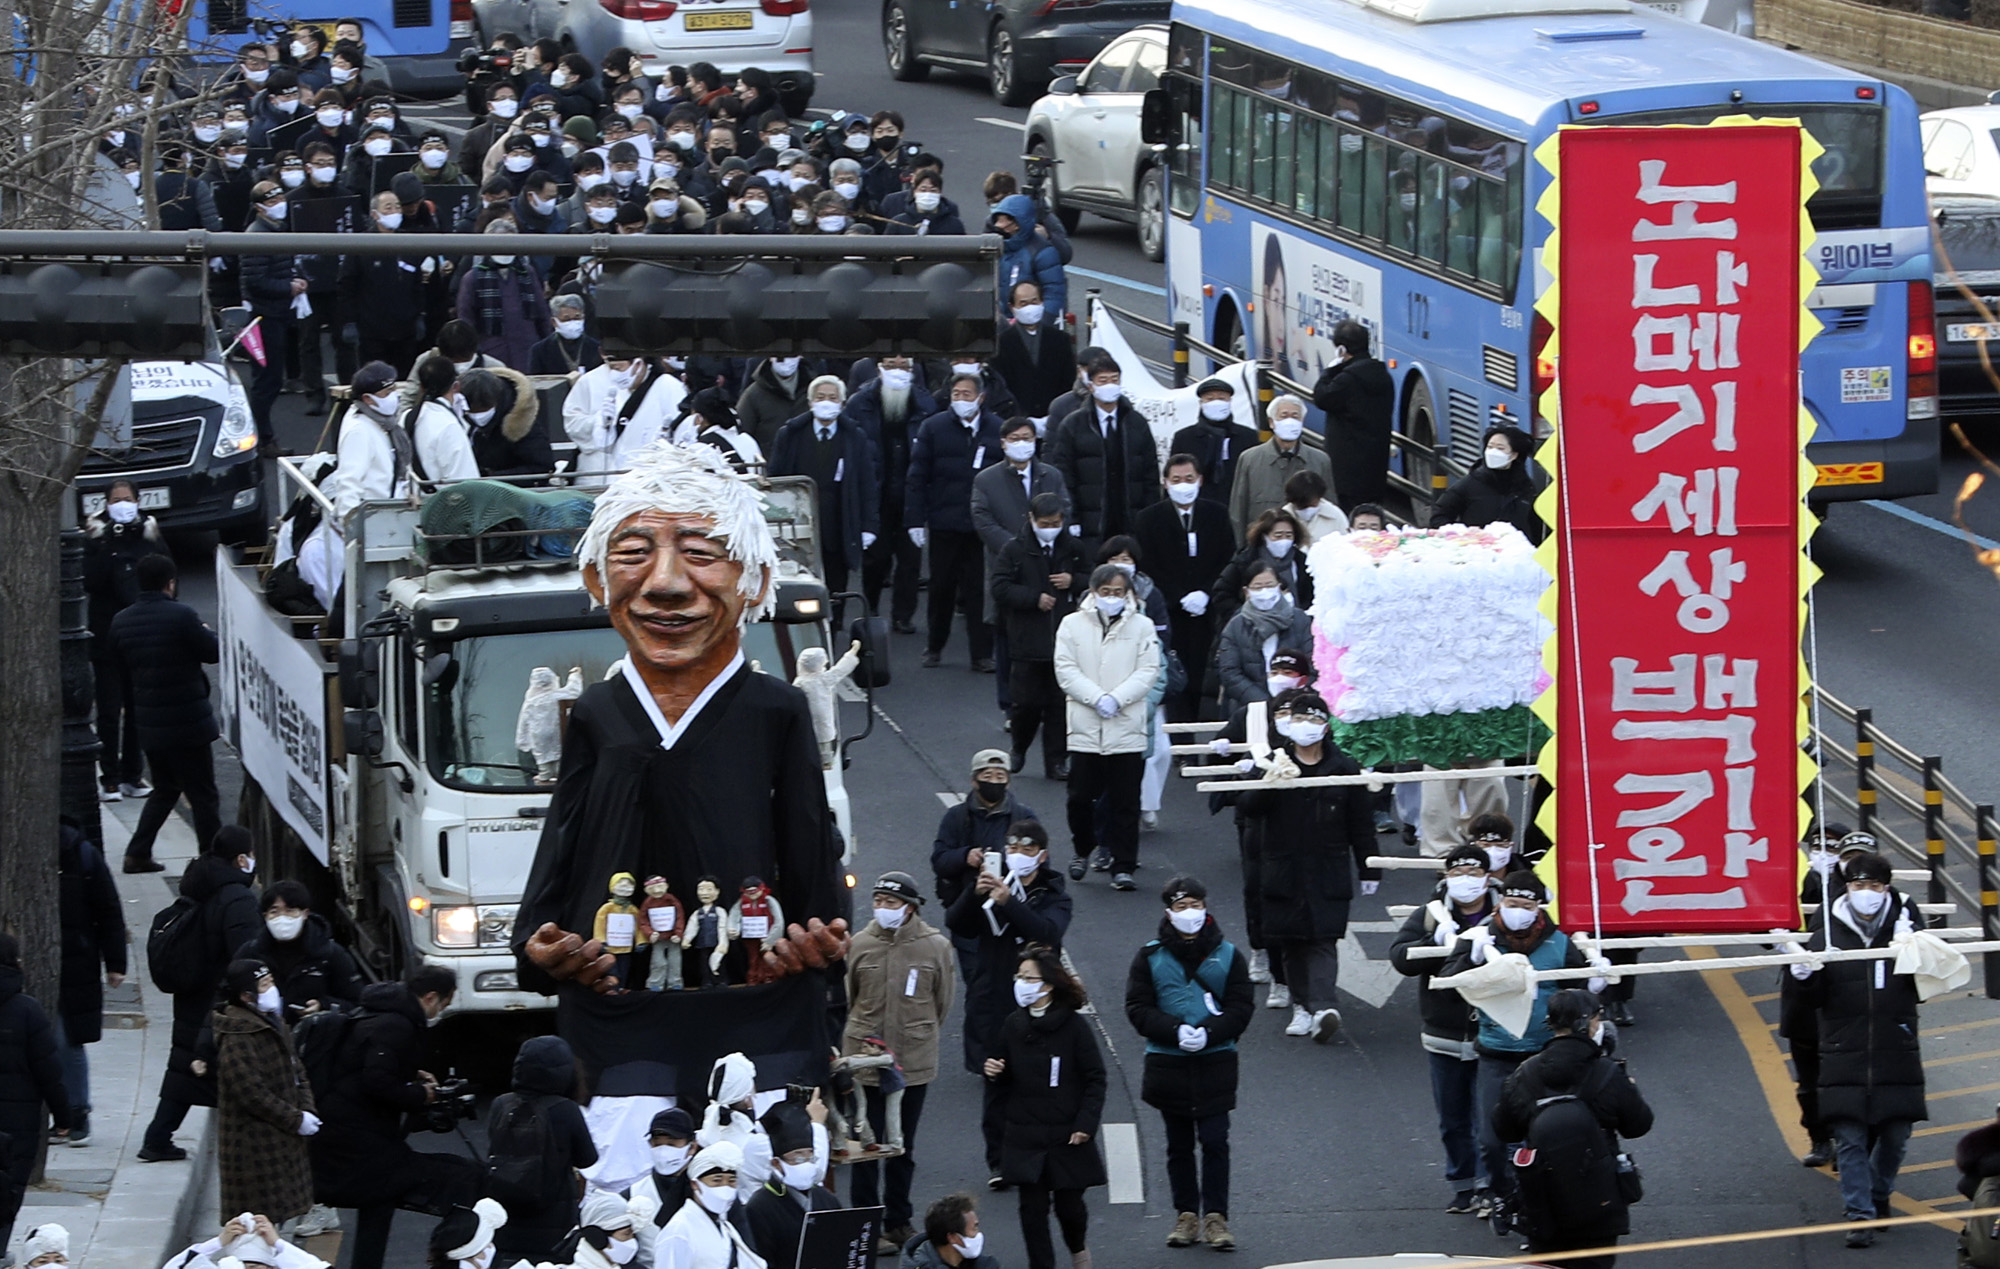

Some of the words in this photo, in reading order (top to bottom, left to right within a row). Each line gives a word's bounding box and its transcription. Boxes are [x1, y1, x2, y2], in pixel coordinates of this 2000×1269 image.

[1820, 242, 1894, 271] 웨이브
[1407, 290, 1430, 340] 172
[1843, 369, 1870, 383] 주의
[1610, 653, 1769, 916] 백기완
[469, 820, 540, 833] HYUNDAI
